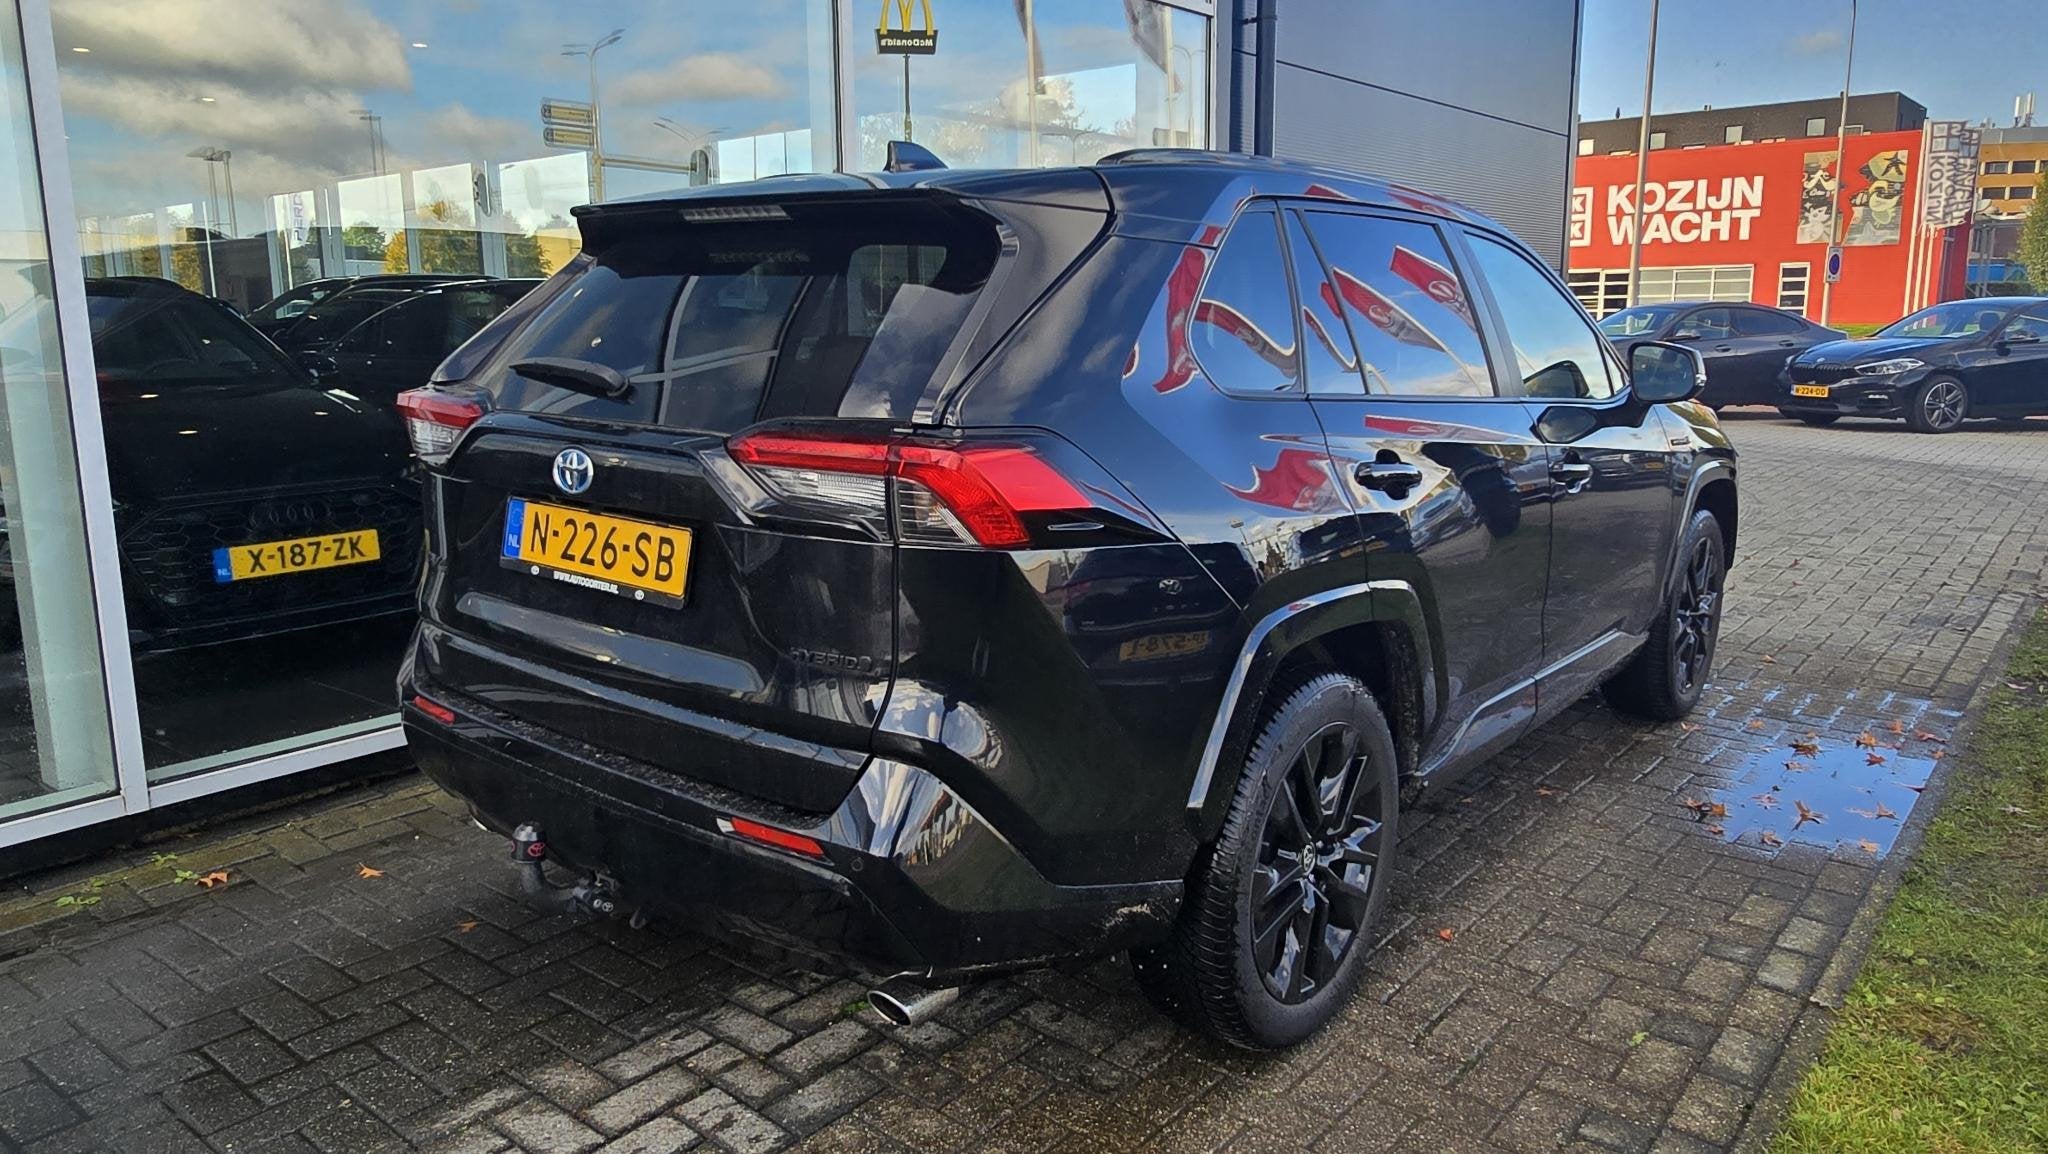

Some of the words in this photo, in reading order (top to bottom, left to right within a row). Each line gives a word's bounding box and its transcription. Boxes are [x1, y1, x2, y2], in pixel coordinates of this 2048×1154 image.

[1607, 176, 1764, 216] KOZIJN
[1607, 208, 1761, 246] WACHT
[247, 535, 367, 573] X-187-ZK
[508, 534, 520, 548] NL
[530, 511, 675, 582] N-226-SB
[217, 568, 231, 576] NL
